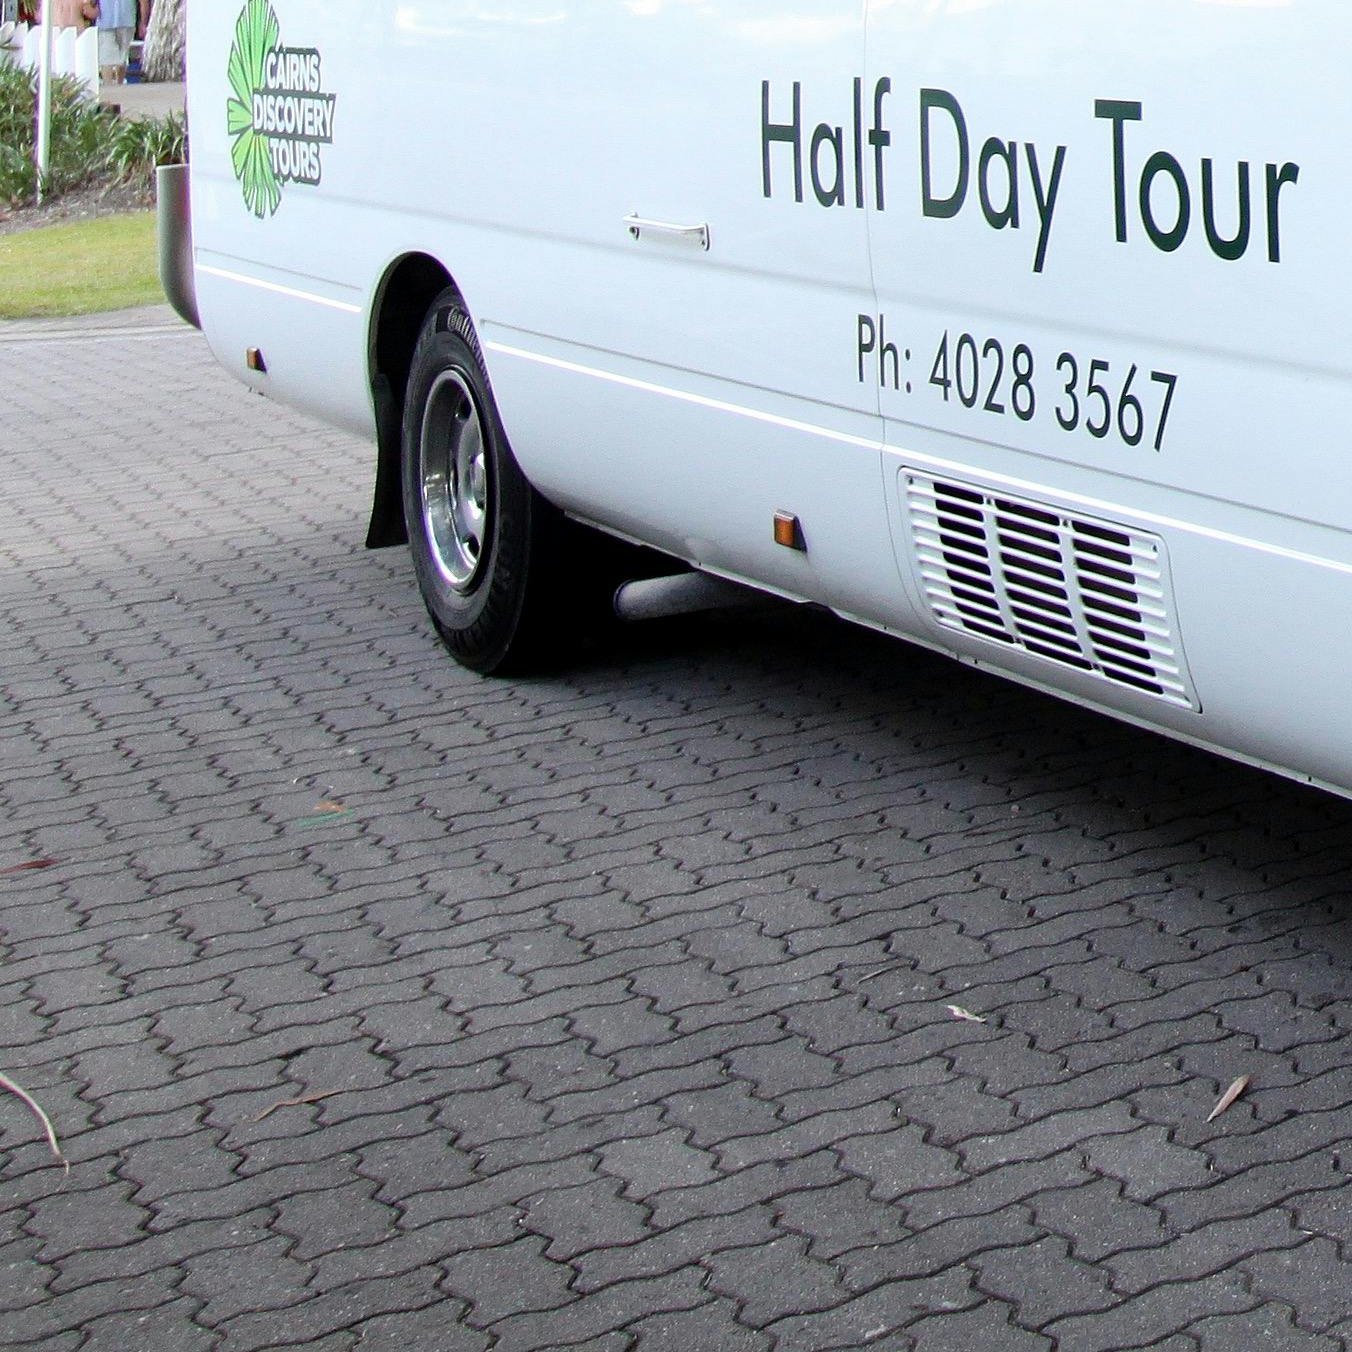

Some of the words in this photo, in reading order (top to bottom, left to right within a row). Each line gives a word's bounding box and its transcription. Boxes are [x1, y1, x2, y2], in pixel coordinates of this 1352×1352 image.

[267, 52, 319, 92] CAIRNS
[254, 94, 334, 138] DISCOVERY
[269, 137, 319, 180] TOURS
[761, 76, 892, 211] Half
[919, 88, 1067, 273] Day
[1094, 99, 1300, 264] Tour
[857, 313, 912, 394] Ph:
[929, 329, 1036, 422] 4028
[1054, 351, 1178, 453] 3567
